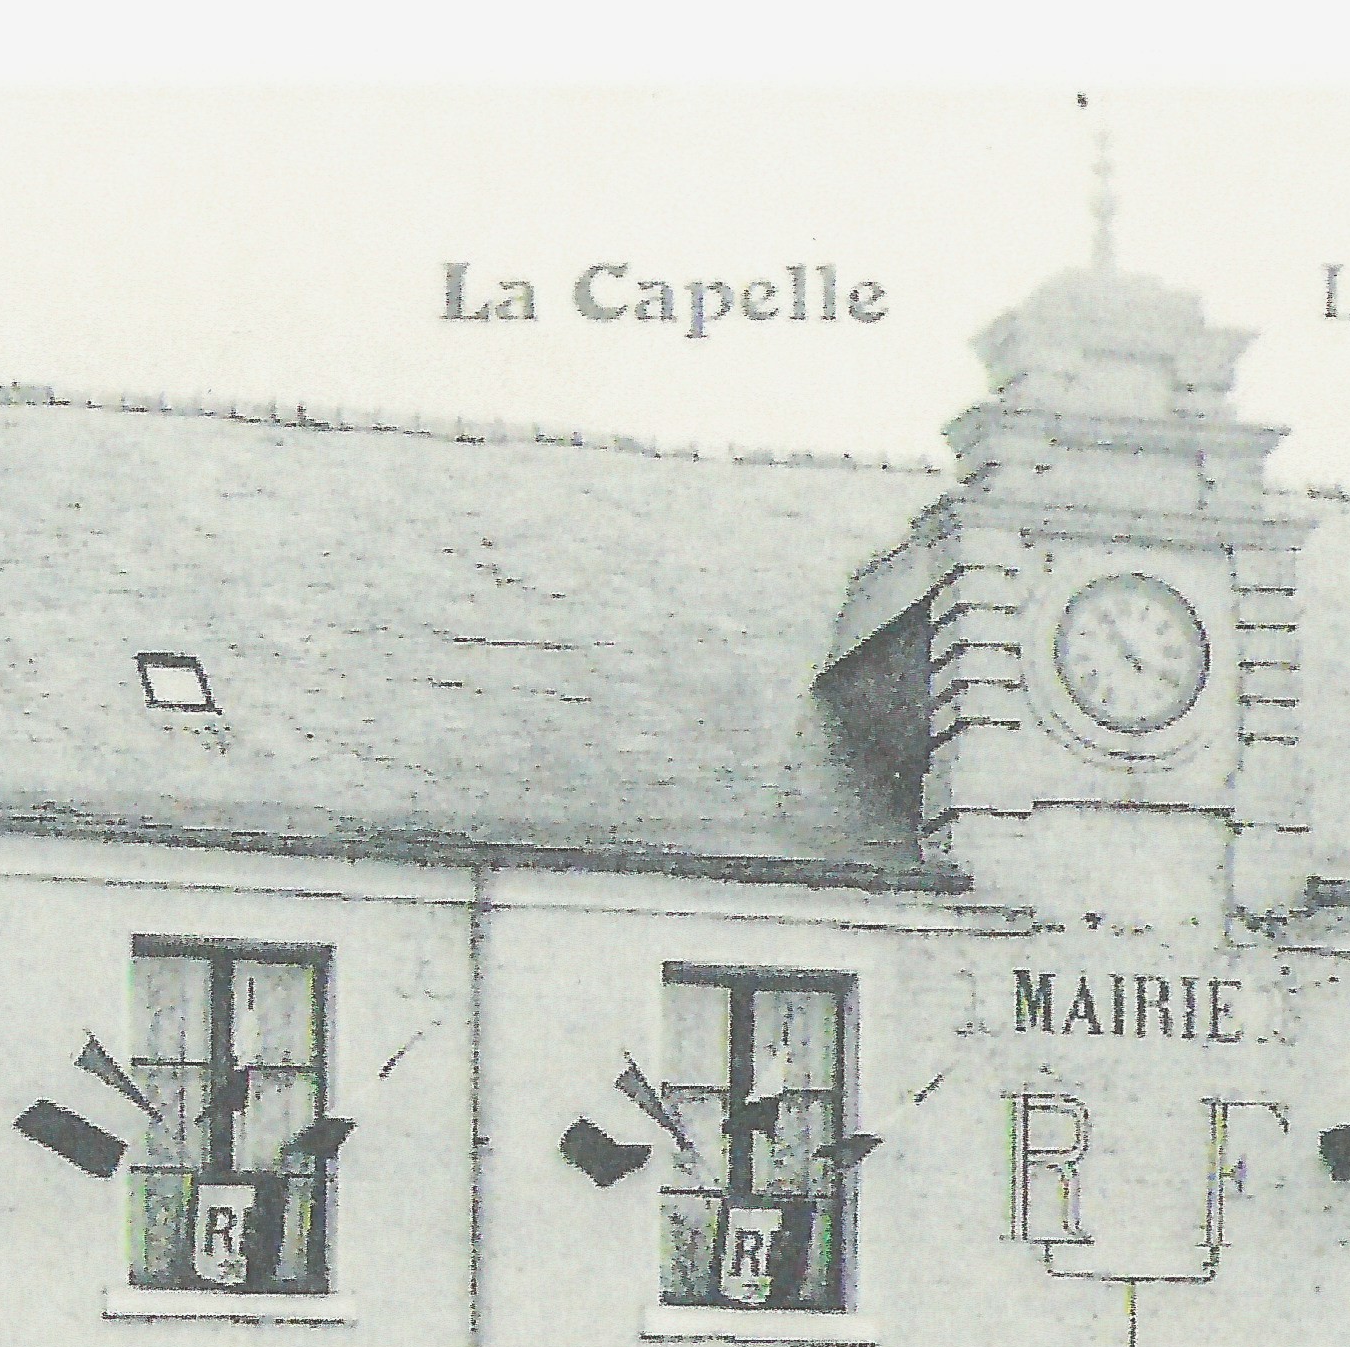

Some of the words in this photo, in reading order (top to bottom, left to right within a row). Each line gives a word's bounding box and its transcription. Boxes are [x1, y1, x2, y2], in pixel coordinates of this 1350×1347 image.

[1013, 969, 1244, 1043] MAIRIE
[1000, 1090, 1096, 1244] R
[1198, 1096, 1290, 1248] F
